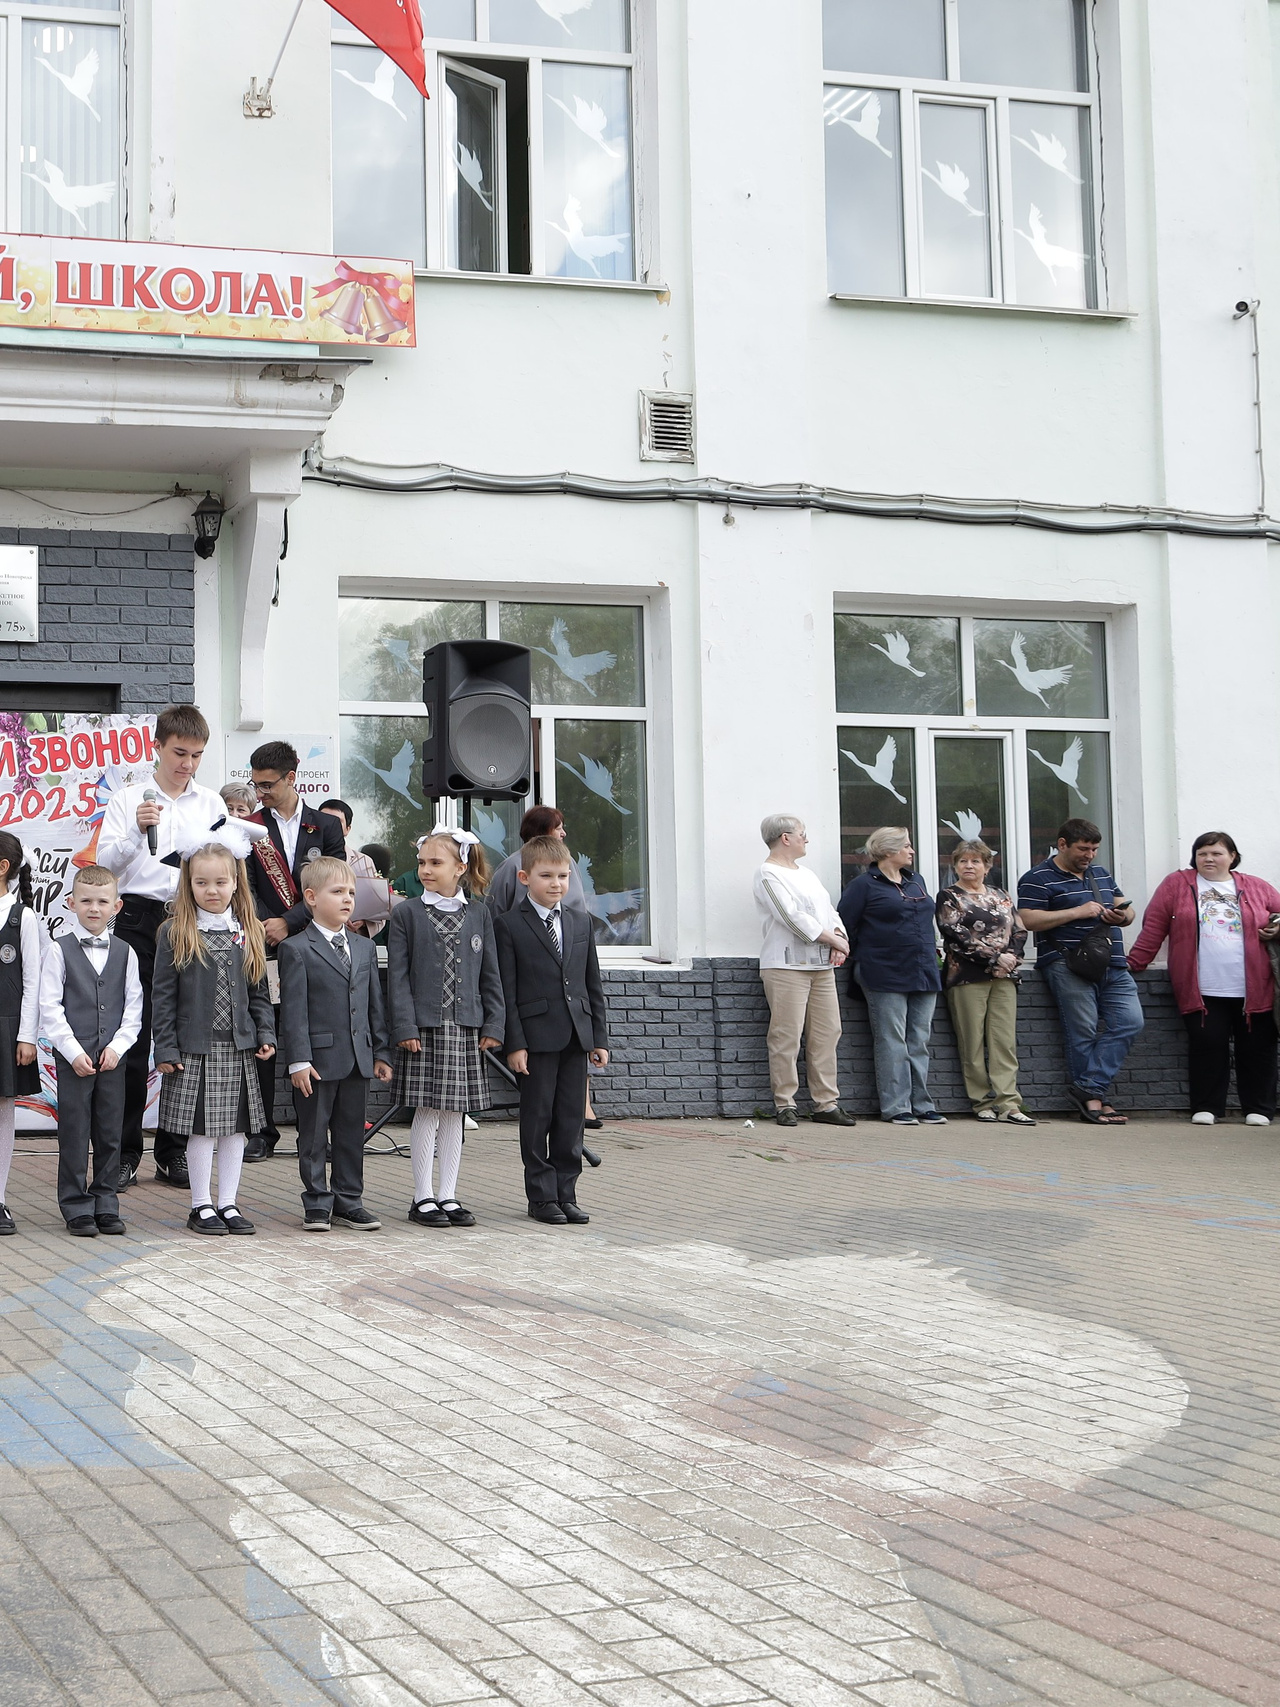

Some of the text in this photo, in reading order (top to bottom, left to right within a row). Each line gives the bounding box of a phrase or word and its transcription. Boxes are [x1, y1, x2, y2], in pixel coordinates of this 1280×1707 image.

[54, 261, 304, 320] ШКОЛА!
[6, 621, 26, 632] 75»
[297, 770, 330, 779] ПРОЕКТ
